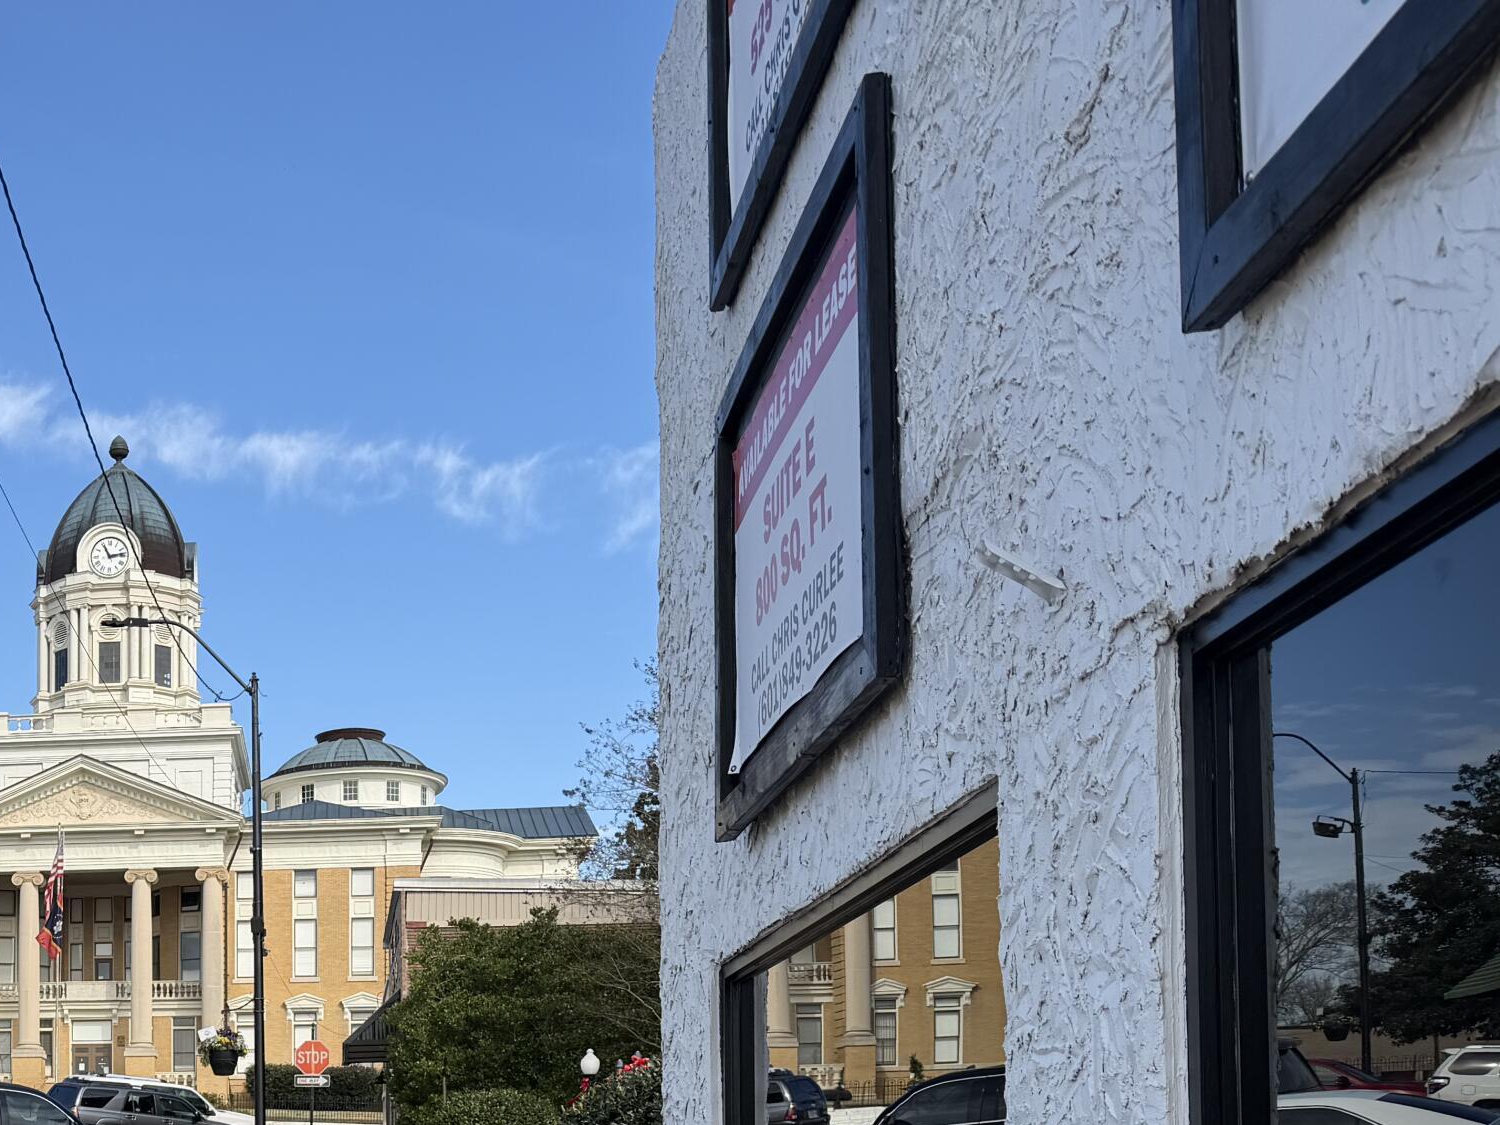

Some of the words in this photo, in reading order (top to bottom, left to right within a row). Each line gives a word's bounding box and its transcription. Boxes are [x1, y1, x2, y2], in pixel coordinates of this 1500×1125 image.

[746, 85, 763, 152] CALL
[765, 4, 790, 94] CHRIS
[739, 376, 787, 502] AVAILABLE
[788, 330, 811, 403] FOR
[815, 241, 857, 356] LEASE
[756, 552, 777, 626] 800
[781, 517, 806, 586] SQ.
[809, 473, 832, 548] FT.
[763, 437, 801, 544] SUITE
[805, 415, 815, 478] E
[752, 645, 770, 694] CALL
[772, 603, 799, 665] CHRIS
[802, 541, 844, 626] CURLEE
[758, 600, 837, 738] (601)849-3226
[297, 1051, 328, 1064] STOP
